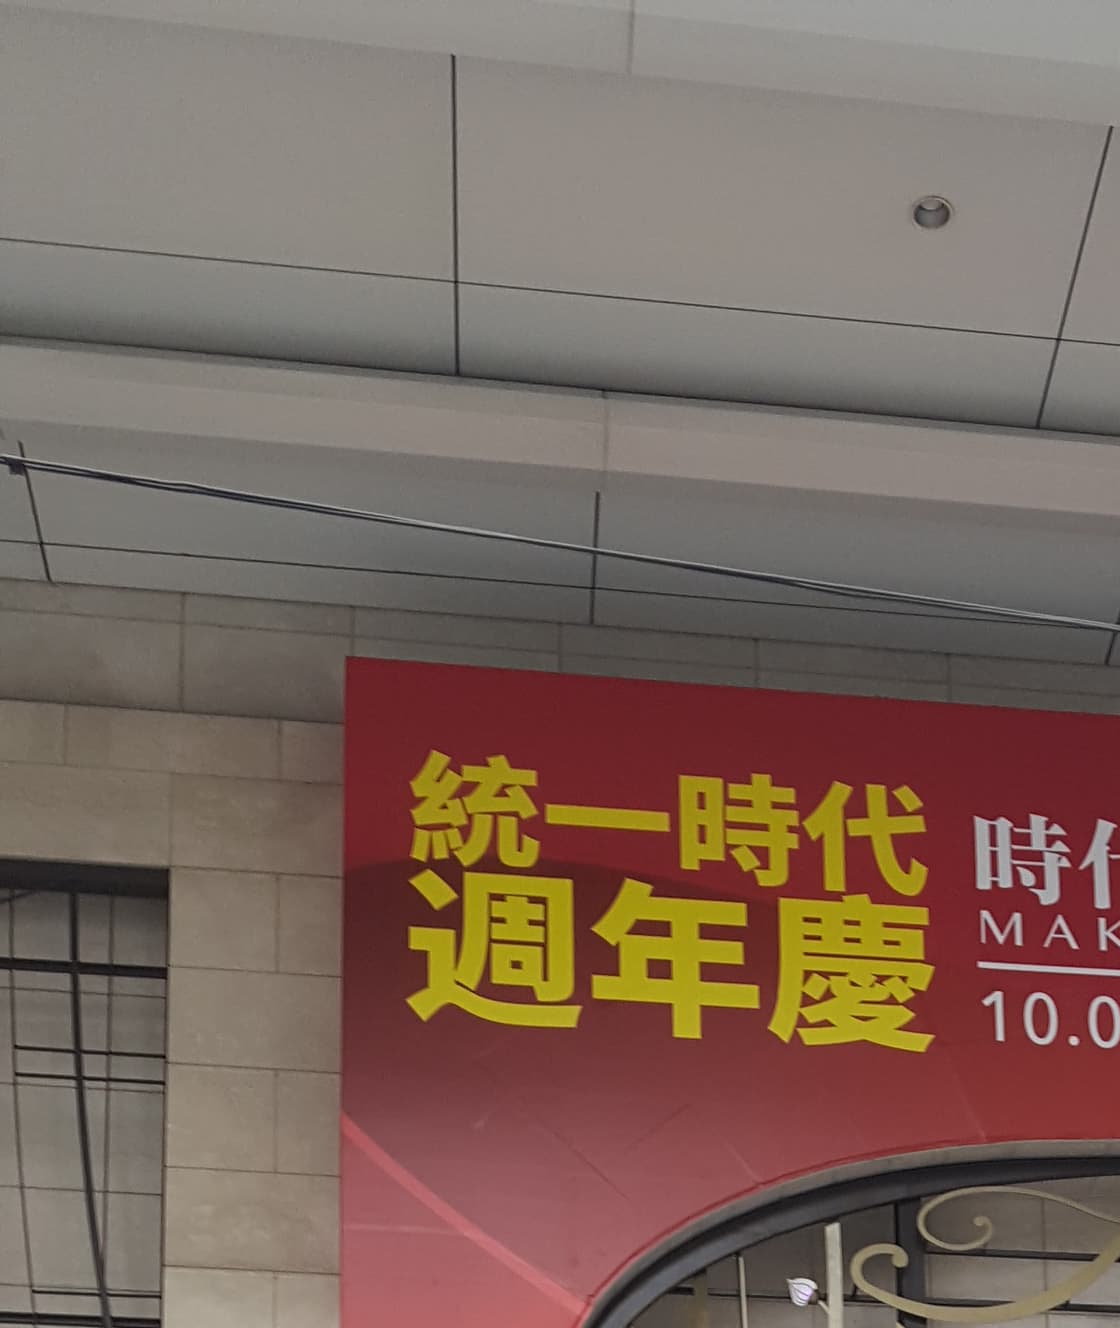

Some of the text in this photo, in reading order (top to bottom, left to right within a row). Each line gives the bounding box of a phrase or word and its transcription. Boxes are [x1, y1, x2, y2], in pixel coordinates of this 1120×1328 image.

[406, 749, 929, 896] 統一時代
[405, 868, 936, 1053] 週年慶
